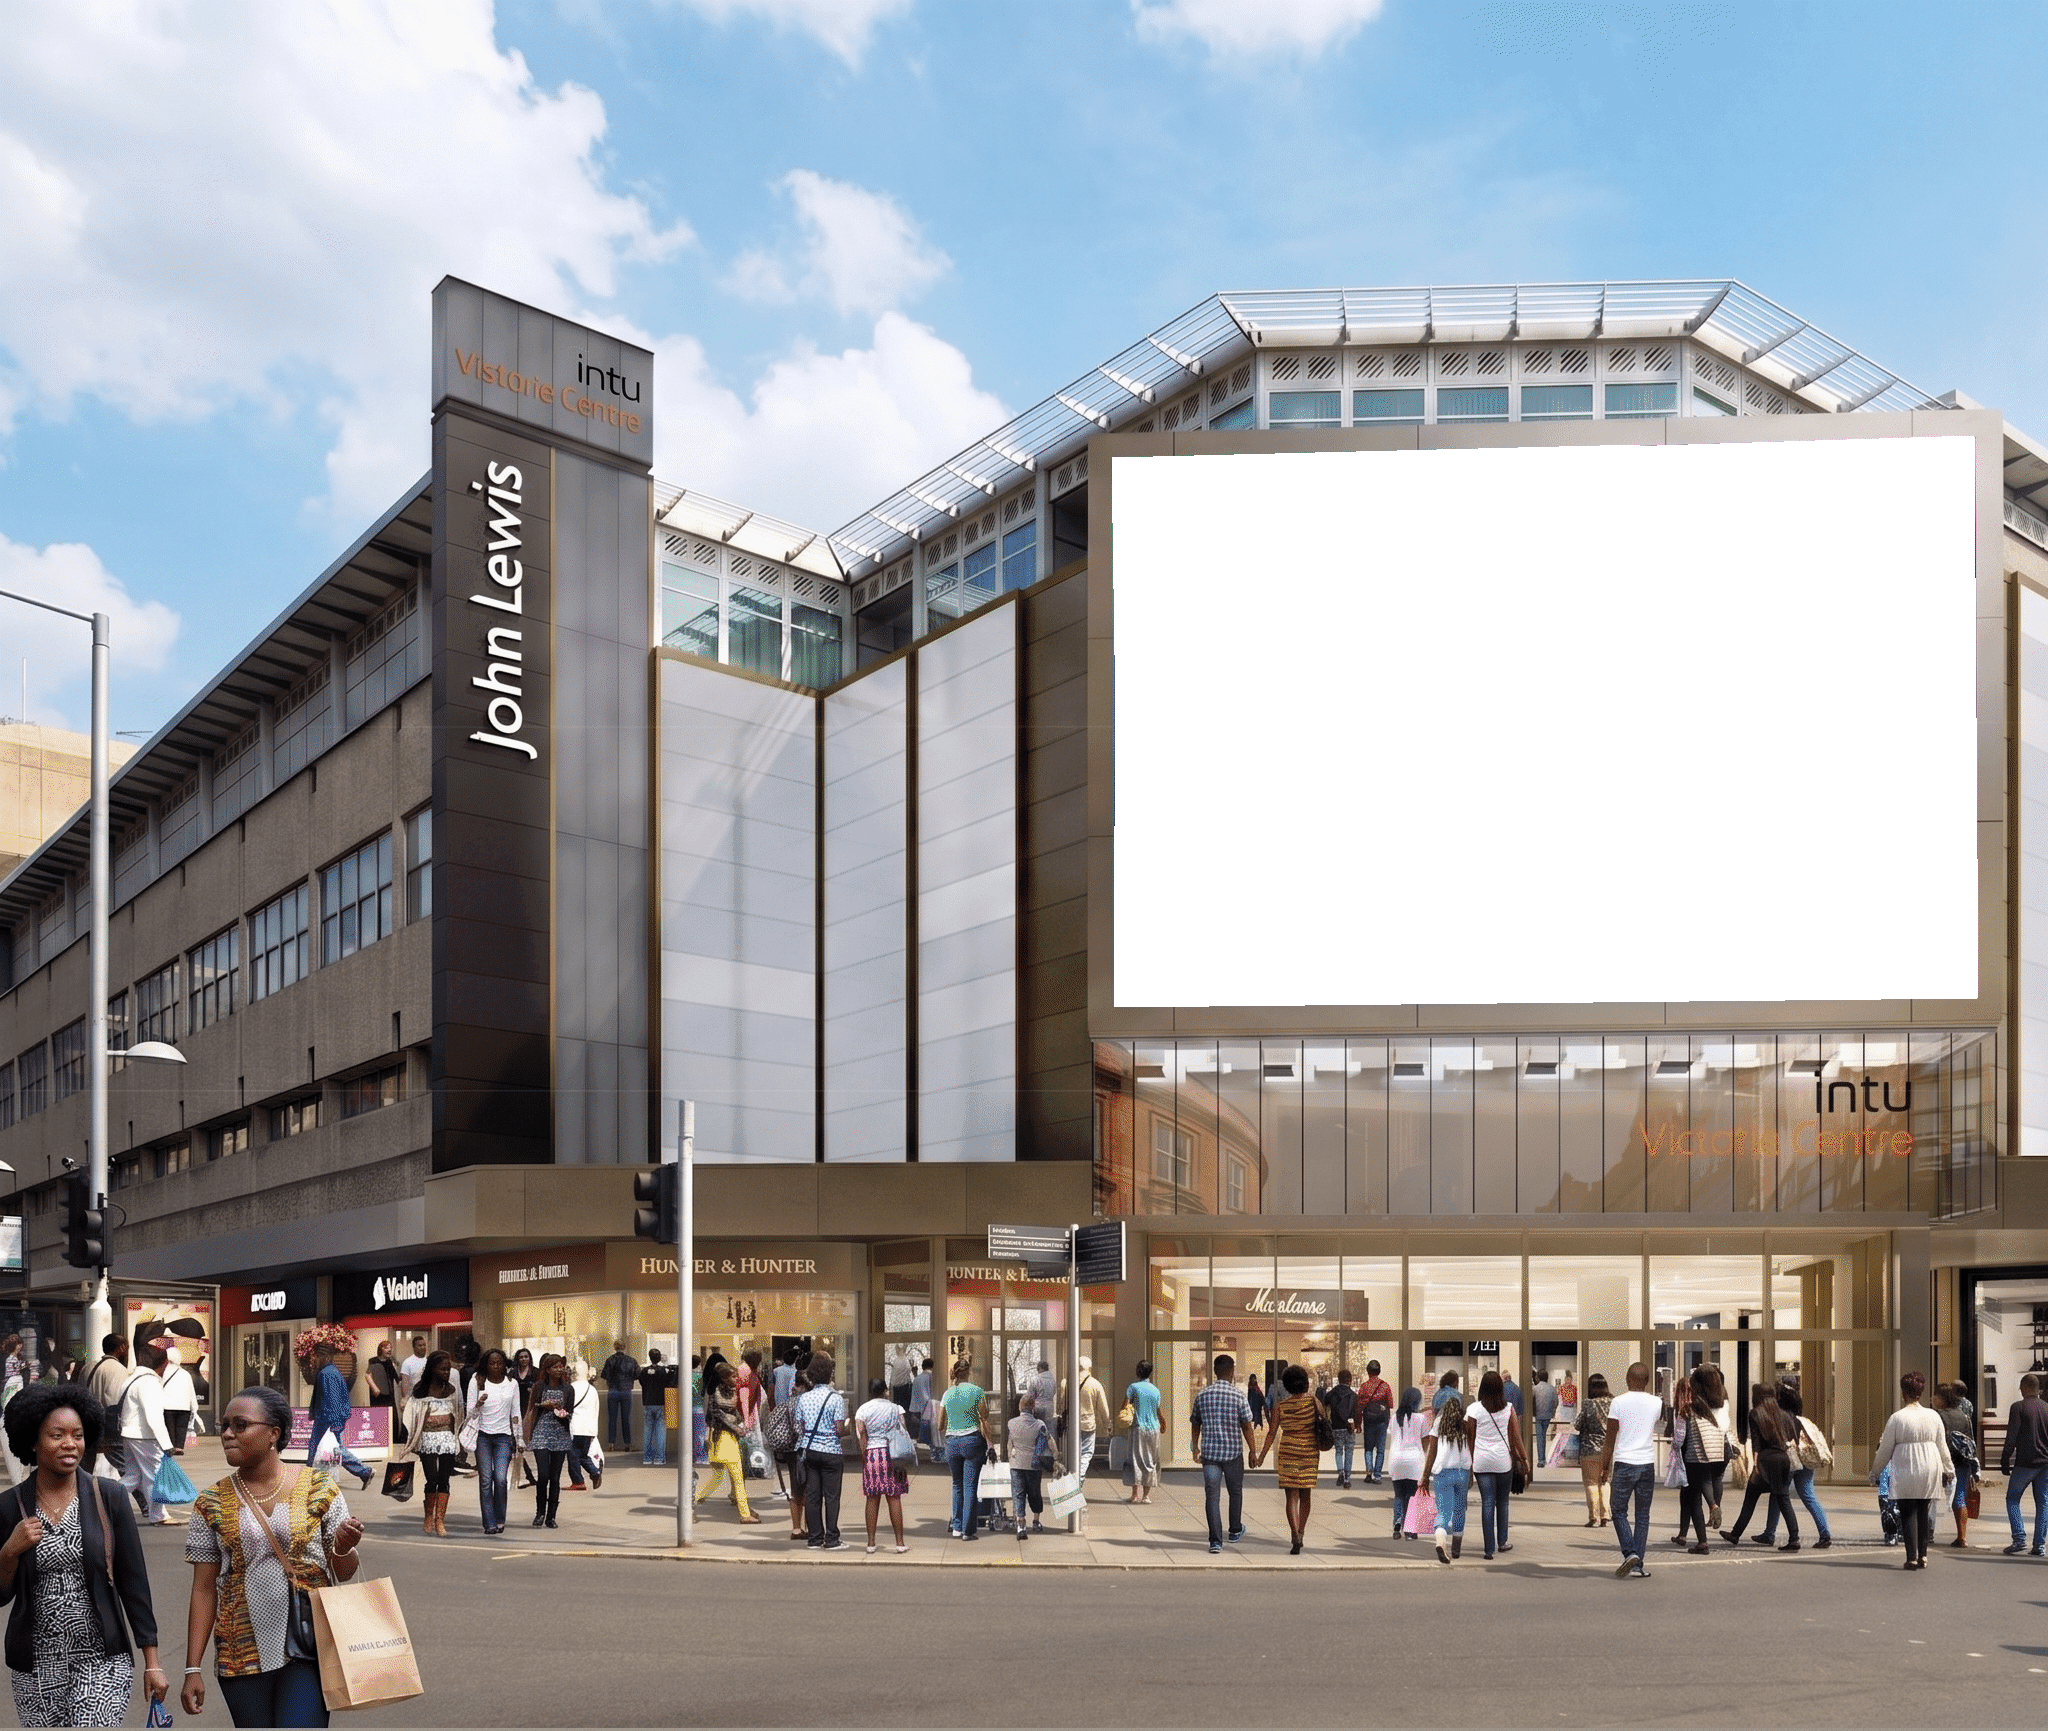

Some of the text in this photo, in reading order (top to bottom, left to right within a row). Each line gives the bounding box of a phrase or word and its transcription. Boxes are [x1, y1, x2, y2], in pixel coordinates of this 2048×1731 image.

[577, 353, 641, 403] intu
[561, 385, 643, 434] Centre
[469, 460, 538, 760] John Lewis
[1813, 1070, 1912, 1114] intu
[1791, 1119, 1914, 1157] Centre
[640, 1257, 818, 1274] HUNER & HUNTER
